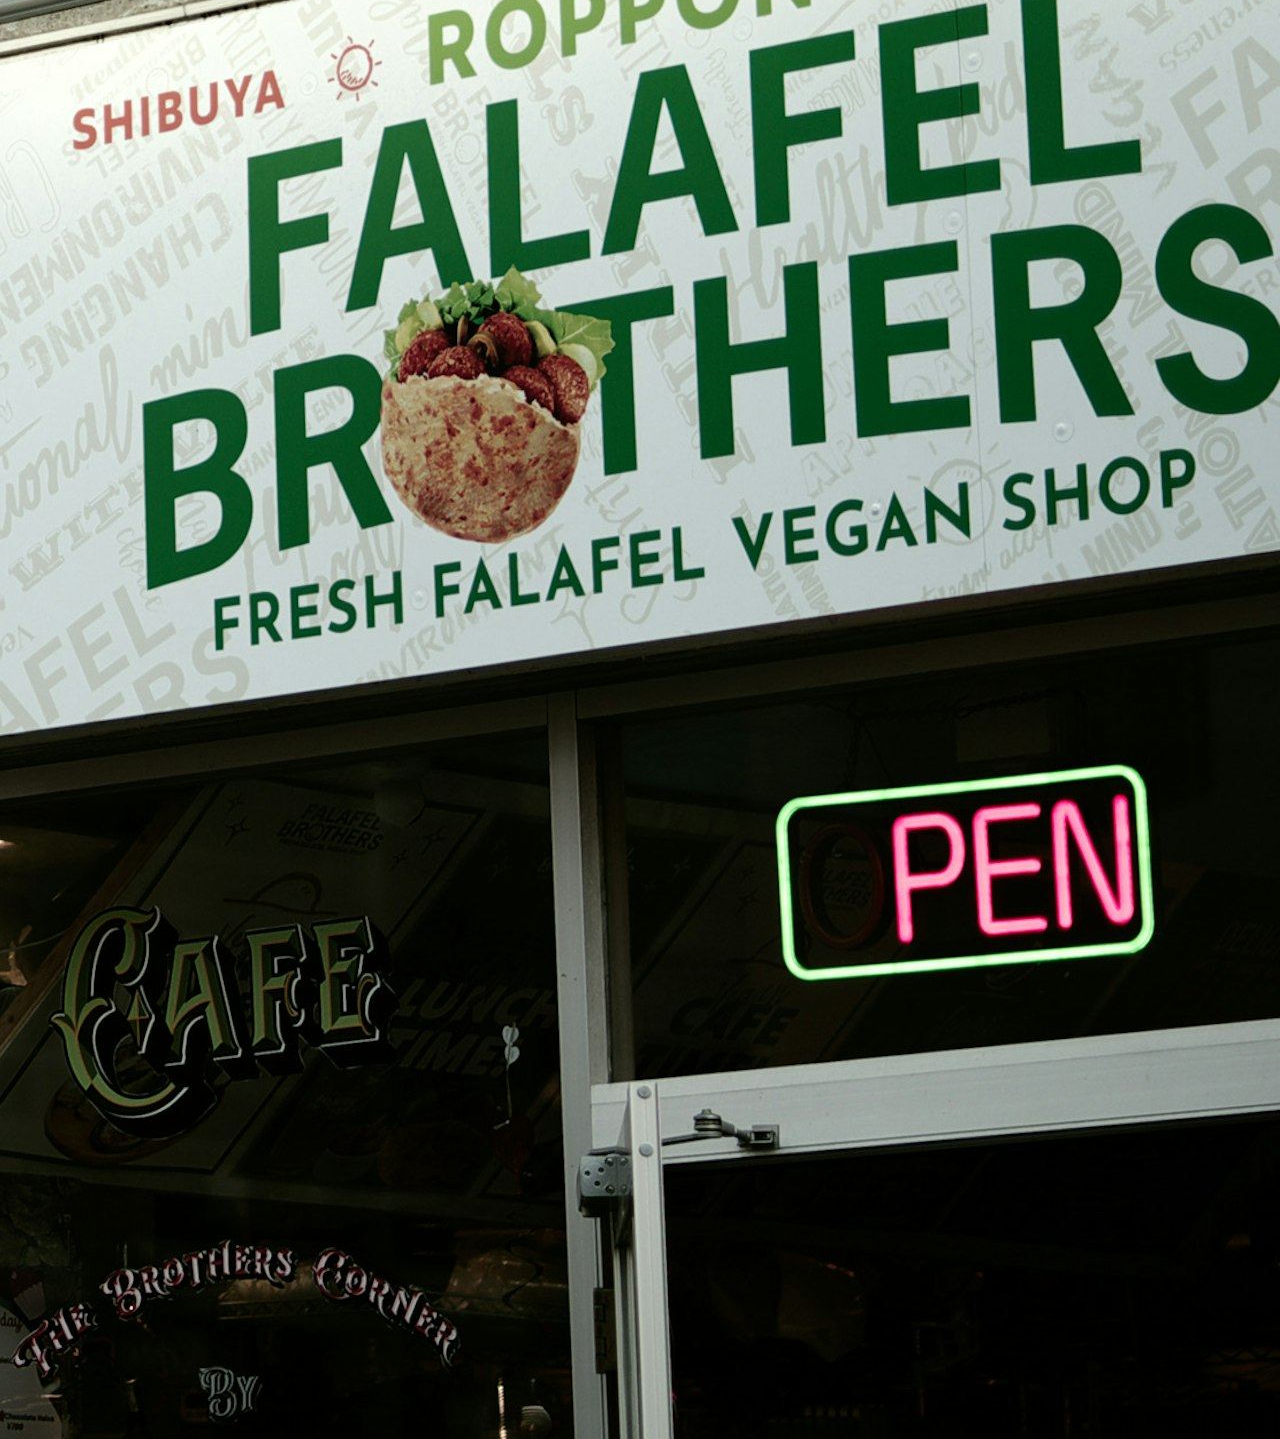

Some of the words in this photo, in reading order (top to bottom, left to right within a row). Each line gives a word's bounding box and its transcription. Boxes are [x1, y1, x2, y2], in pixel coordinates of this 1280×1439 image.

[72, 70, 286, 151] SHIBUYA
[212, 570, 405, 651] FRESH
[433, 526, 707, 619] FALAFEL
[731, 480, 973, 572] VEGAN
[1002, 448, 1197, 532] SHOP
[50, 905, 386, 1123] CAFE
[11, 1301, 98, 1377] THE
[99, 1239, 298, 1320] BROTHERS
[312, 1245, 463, 1371] CORNER
